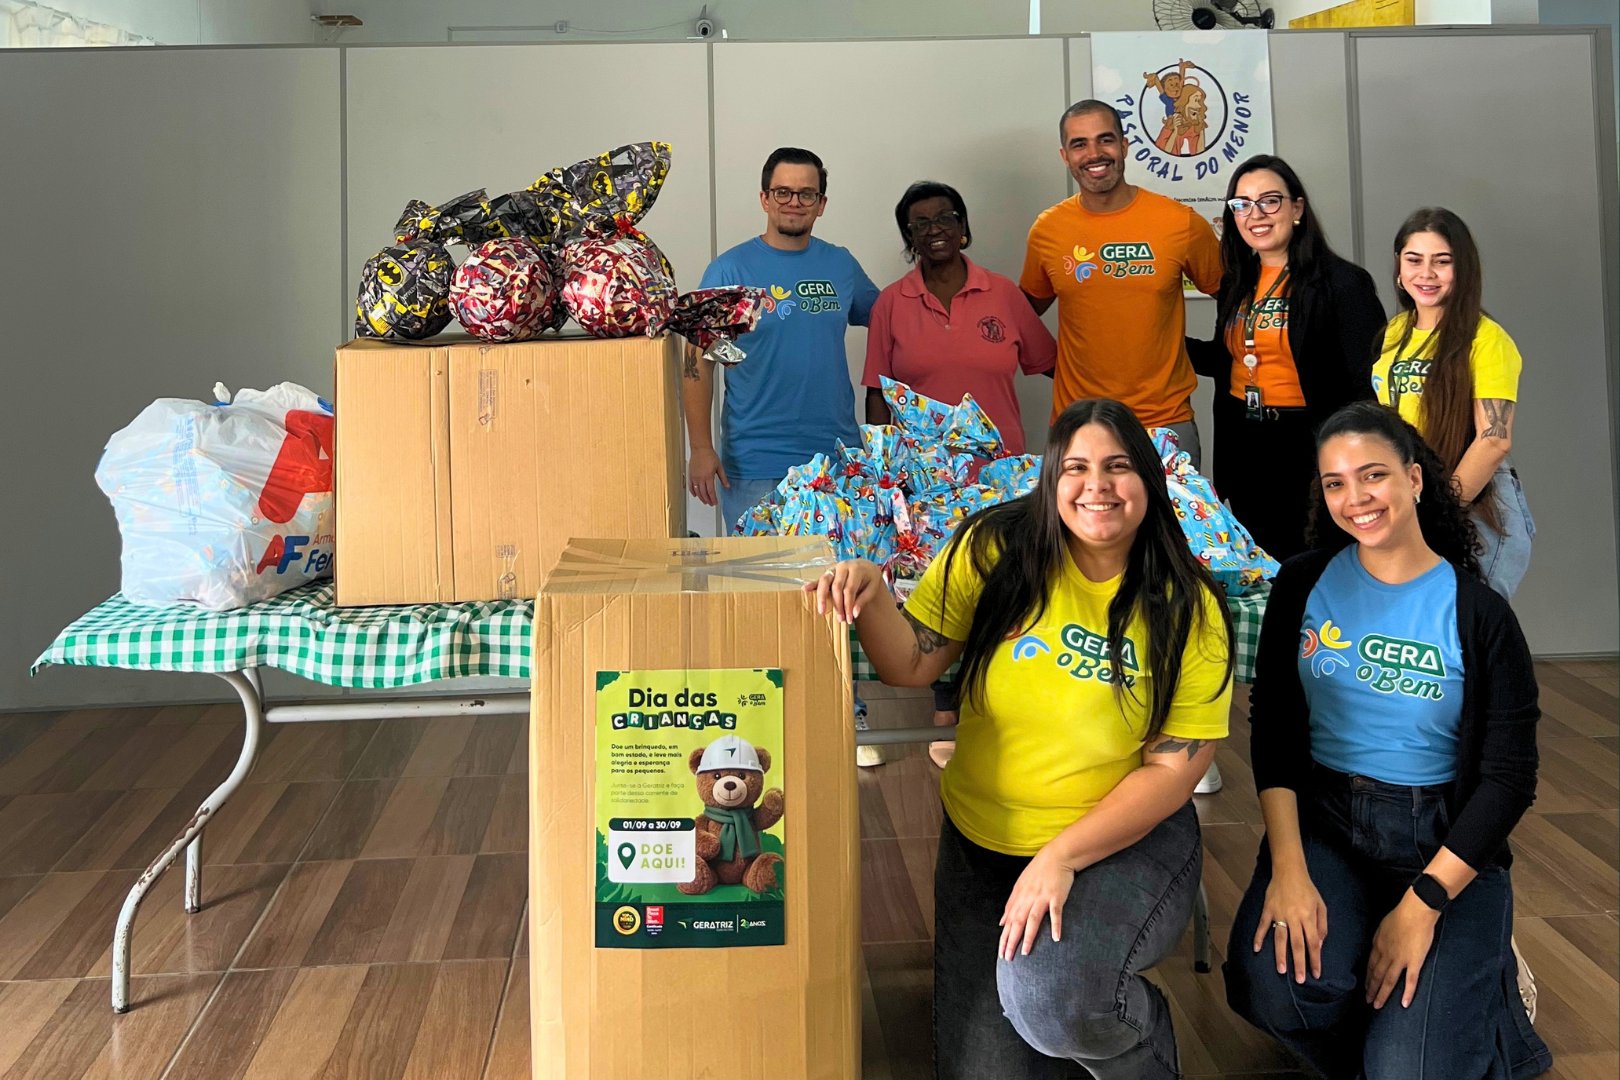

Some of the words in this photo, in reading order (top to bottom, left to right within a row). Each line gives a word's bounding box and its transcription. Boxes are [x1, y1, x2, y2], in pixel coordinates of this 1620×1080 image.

[1116, 94, 1183, 181] PASTORAL
[1195, 156, 1218, 180] DO
[1222, 92, 1251, 163] MENOR
[1102, 245, 1150, 259] GERA
[1113, 261, 1155, 278] Bem
[798, 283, 834, 295] GERA
[809, 297, 841, 313] Bem
[1257, 313, 1288, 329] Be
[1399, 375, 1423, 394] Be
[256, 534, 310, 574] AF
[1364, 639, 1439, 671] GERA
[1356, 664, 1374, 681] o
[1370, 668, 1444, 700] Bem
[628, 687, 668, 707] Dia
[674, 687, 718, 707] das
[612, 711, 736, 730] CRIANÇAS
[634, 743, 667, 751] brinquedo,
[622, 821, 647, 829] 01/09
[656, 821, 681, 829] 30/09
[640, 843, 673, 855] DOE
[640, 857, 686, 869] AQUI!
[693, 921, 734, 929] GERATRIZ
